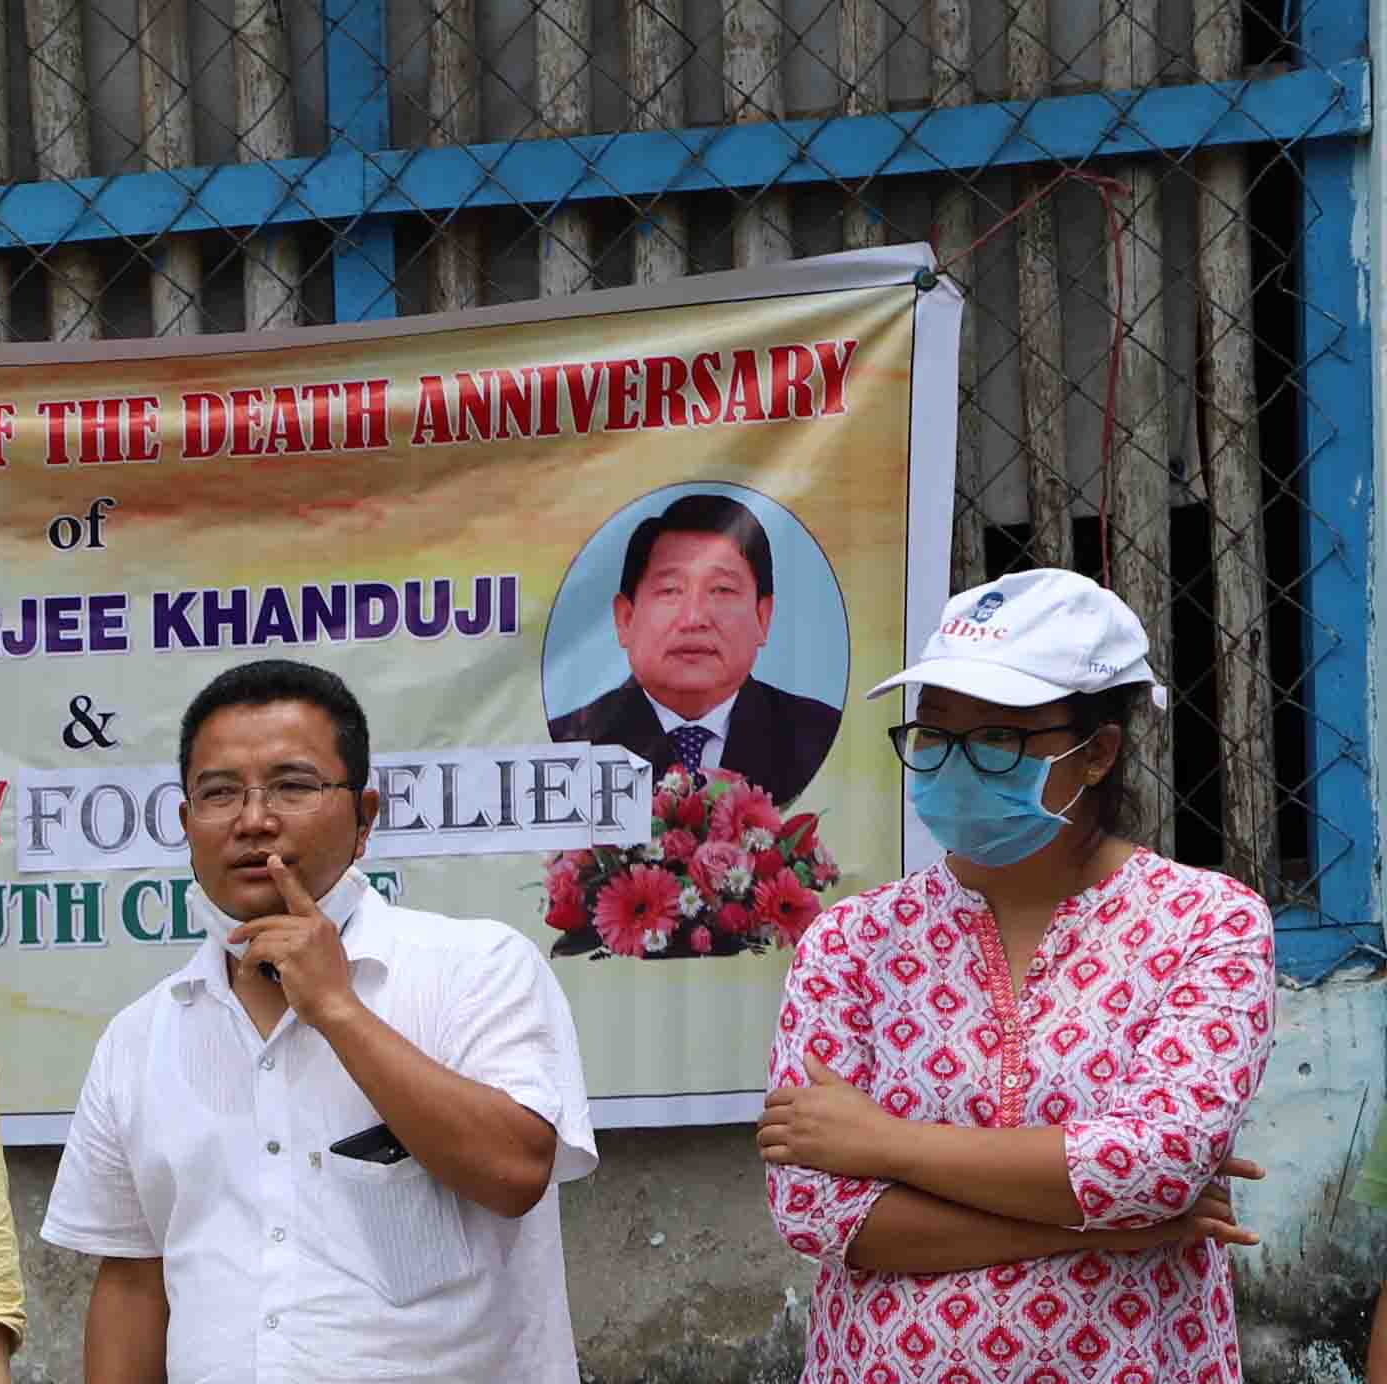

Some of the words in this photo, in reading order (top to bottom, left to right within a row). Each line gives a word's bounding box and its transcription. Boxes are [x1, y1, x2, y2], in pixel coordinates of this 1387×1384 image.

[39, 396, 160, 466] THE
[181, 378, 390, 460] DEATH
[411, 339, 858, 448] ANNIVERSARY
[47, 497, 114, 550] of
[151, 575, 521, 653] KHANDUJI
[61, 694, 117, 750] &
[24, 781, 189, 855] FOO
[373, 756, 637, 835] ELIEF
